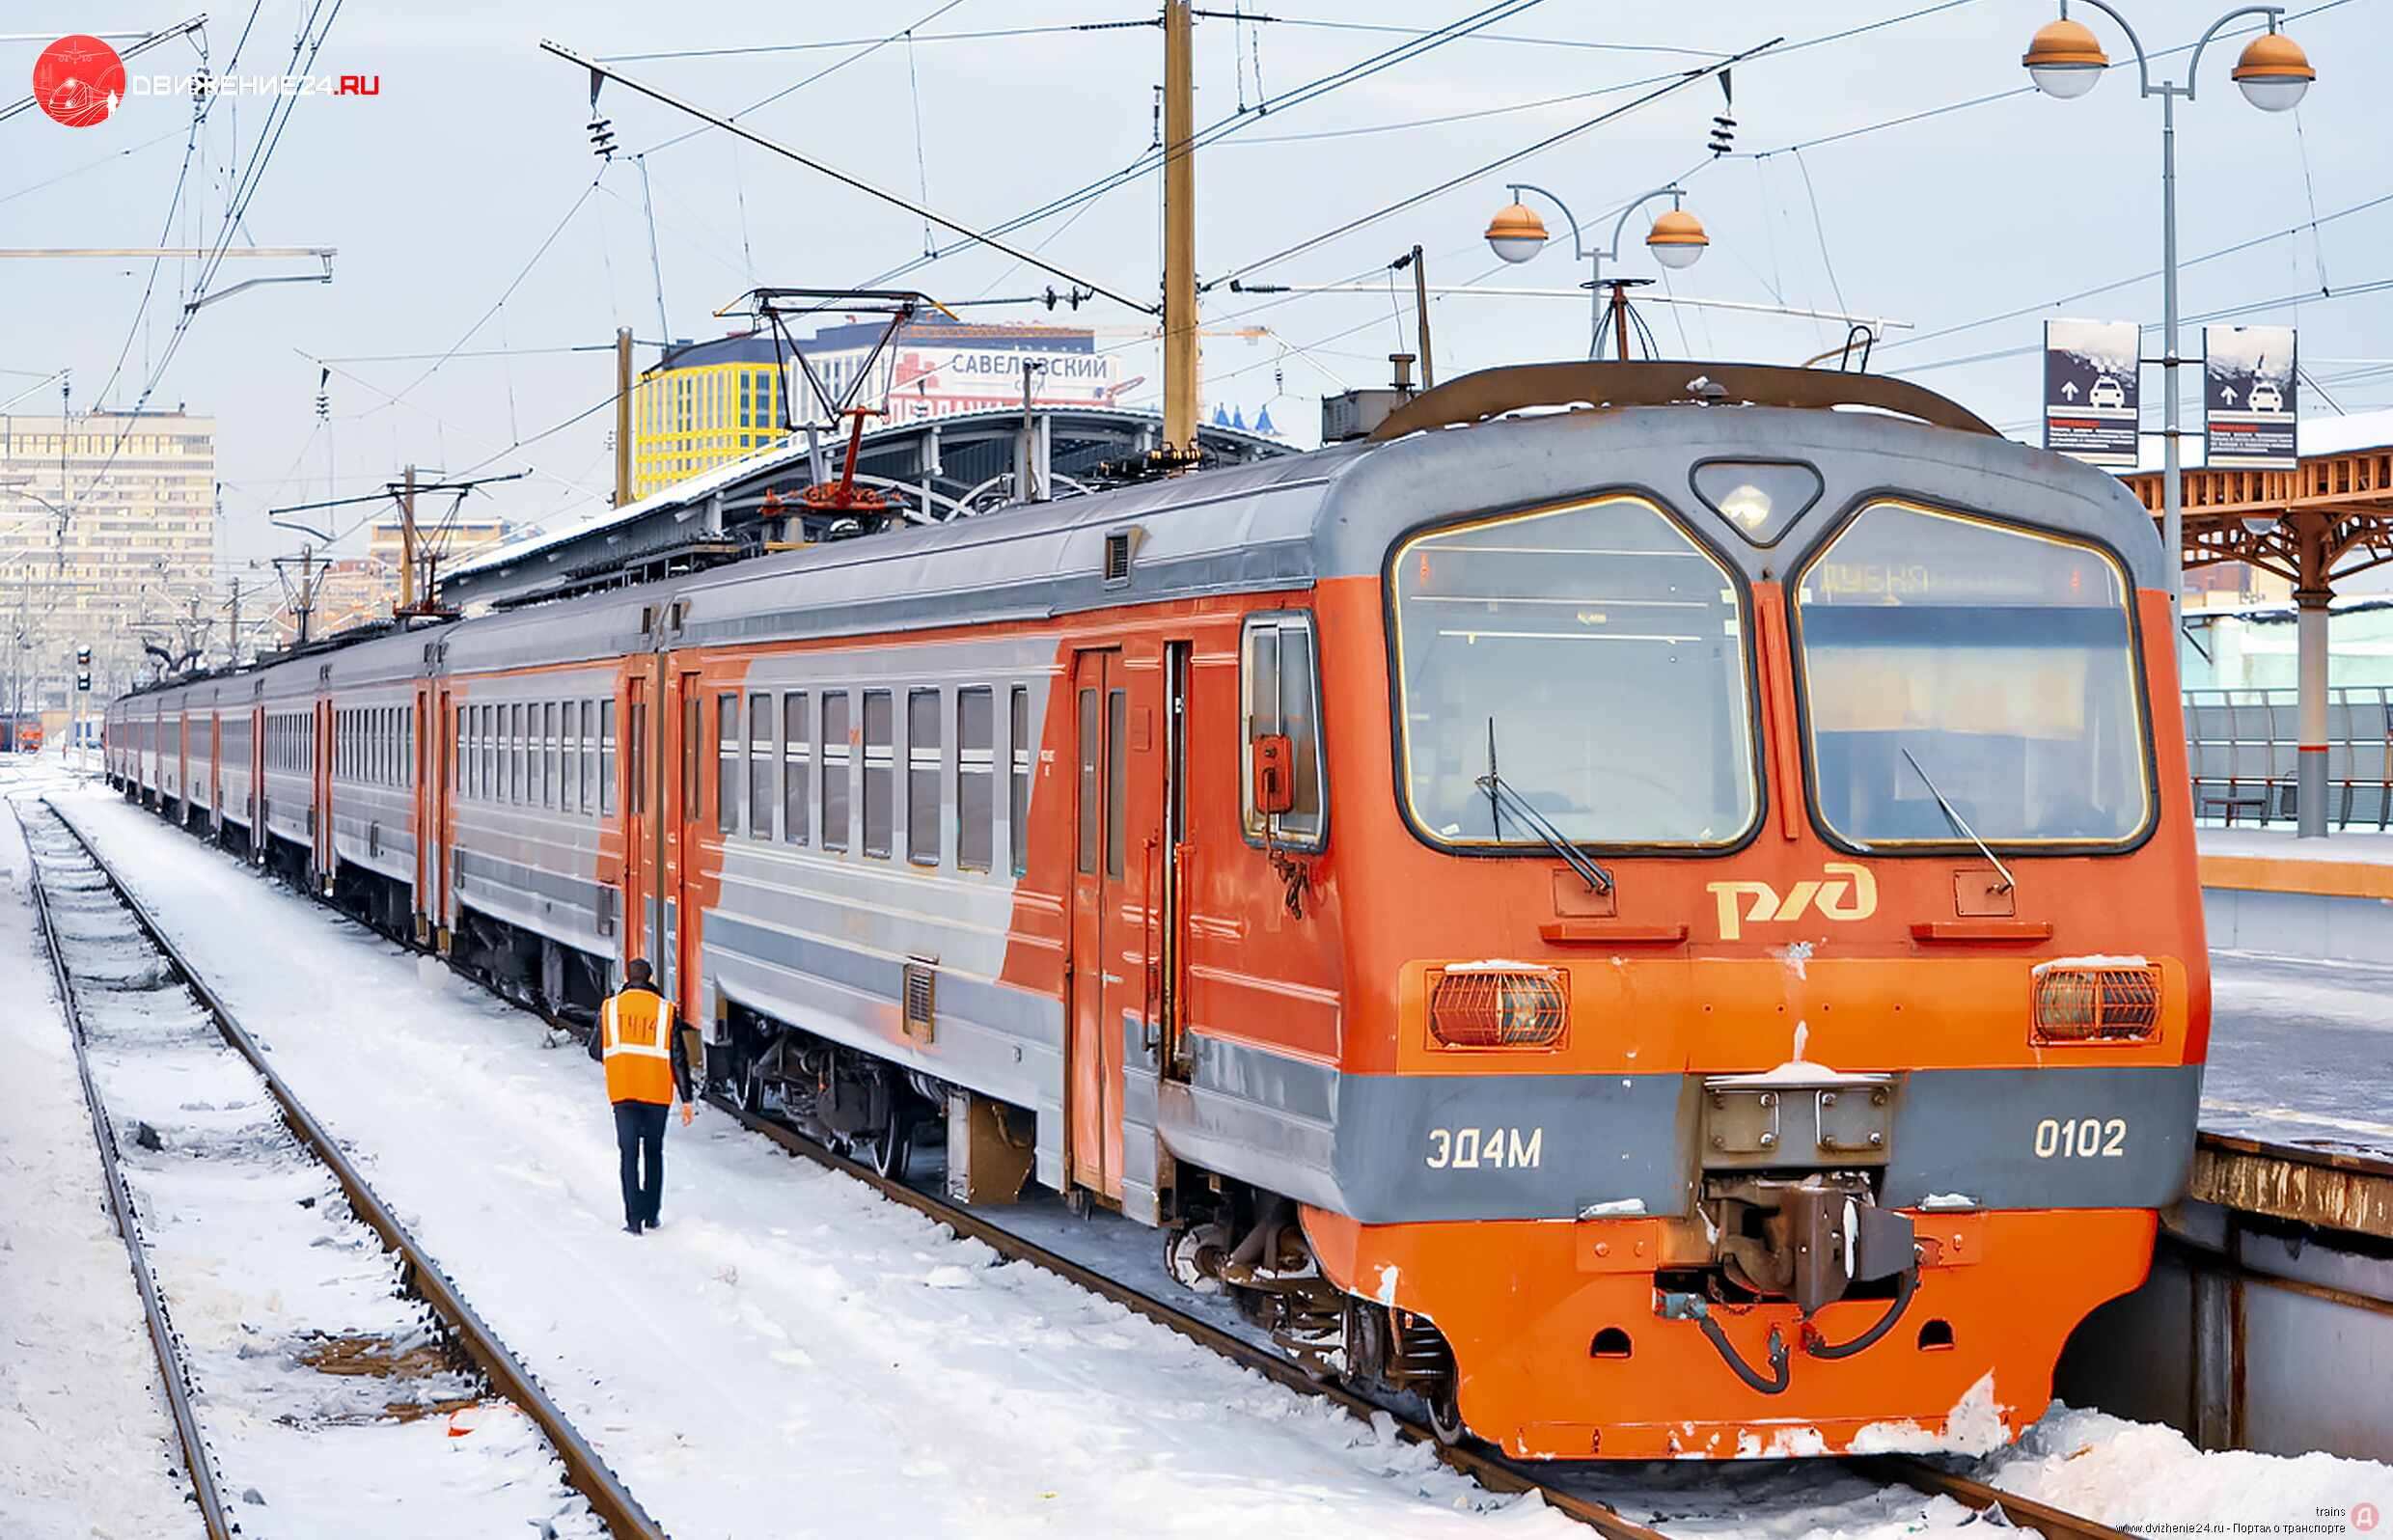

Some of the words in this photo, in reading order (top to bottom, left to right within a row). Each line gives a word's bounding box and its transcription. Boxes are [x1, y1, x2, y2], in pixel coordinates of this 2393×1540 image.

[951, 353, 1108, 379] САВЕЛОВСКИЙ
[1426, 1127, 1542, 1169] ЭД4М
[2035, 1118, 2127, 1158] 0102
